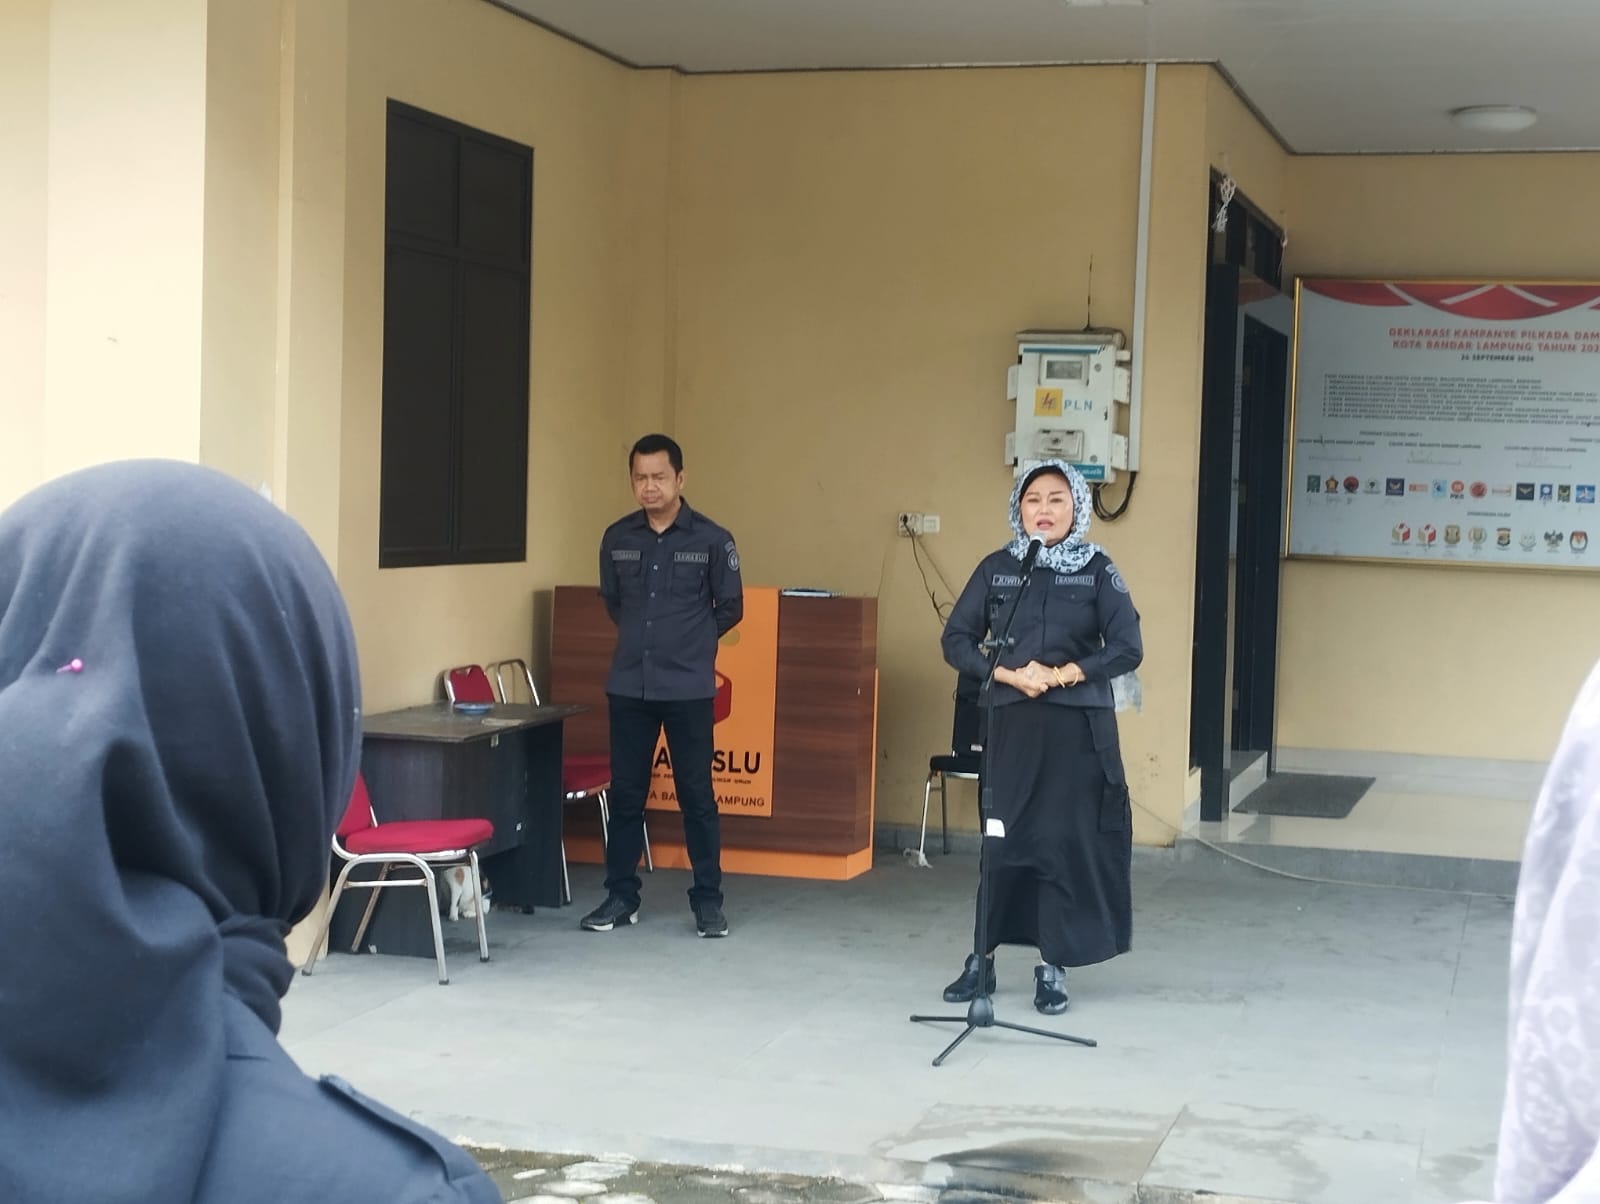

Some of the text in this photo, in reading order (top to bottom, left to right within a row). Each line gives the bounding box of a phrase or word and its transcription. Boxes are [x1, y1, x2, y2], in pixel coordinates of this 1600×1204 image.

[1388, 328, 1451, 338] DEKLARASI
[1453, 329, 1516, 339] KAMPANYE
[1520, 330, 1569, 340] PILKADA
[1393, 340, 1422, 349] KOTA
[1426, 341, 1472, 350] BANDAR
[1476, 342, 1532, 352] LAMPUNG
[1537, 343, 1576, 353] TAHUN
[1063, 399, 1093, 411] PLN
[716, 794, 765, 807] AMPUNG
